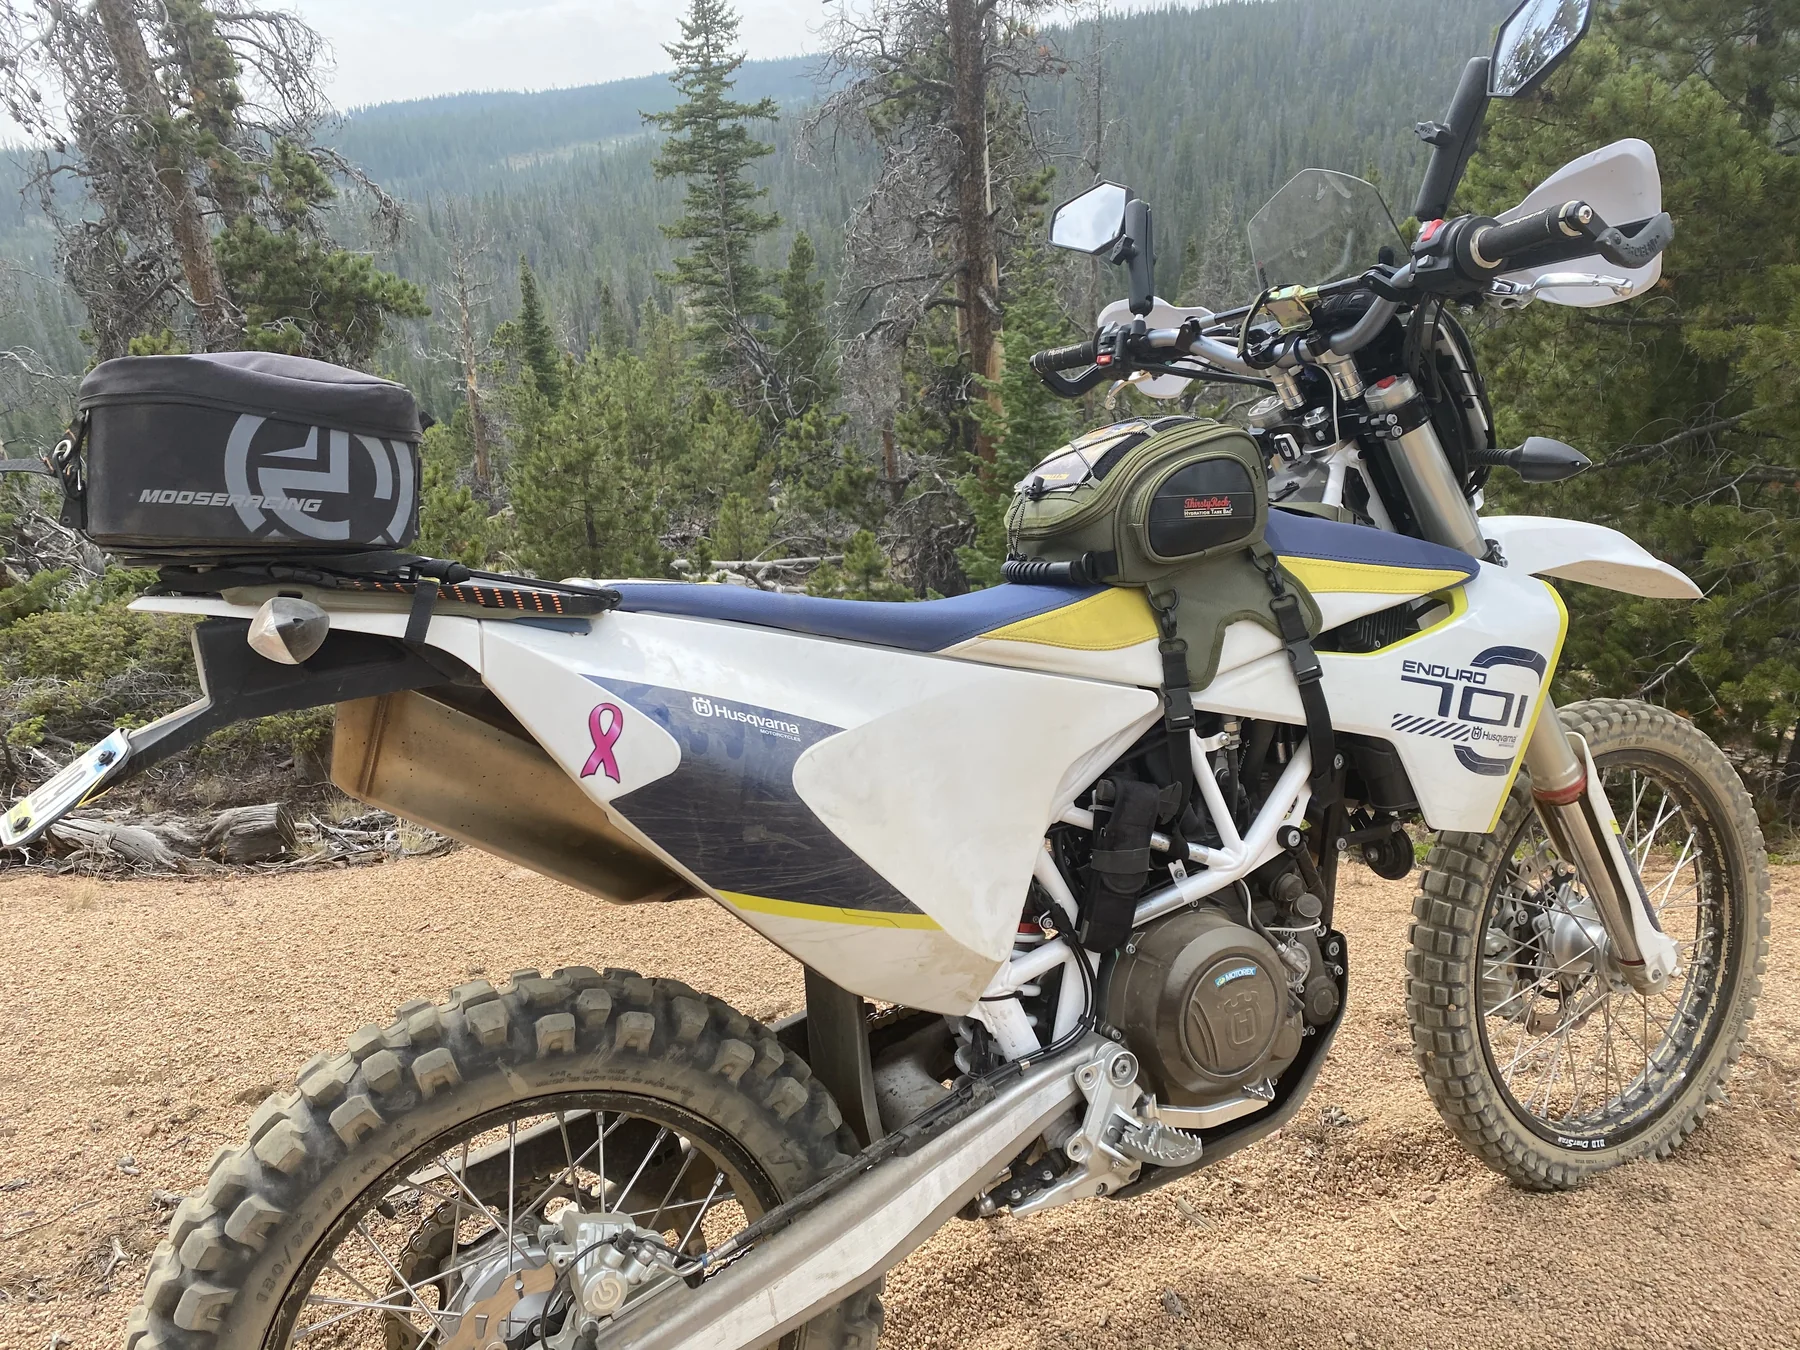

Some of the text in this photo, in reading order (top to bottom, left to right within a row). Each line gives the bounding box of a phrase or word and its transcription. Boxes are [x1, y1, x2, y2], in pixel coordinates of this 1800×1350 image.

[1402, 659, 1487, 685] ENDURO
[1401, 675, 1528, 729] 701
[714, 704, 800, 735] Husqvarna
[760, 728, 801, 742] MOTORCYCLES
[1482, 730, 1517, 743] Husqvarna
[1225, 967, 1254, 982] MOTOREX
